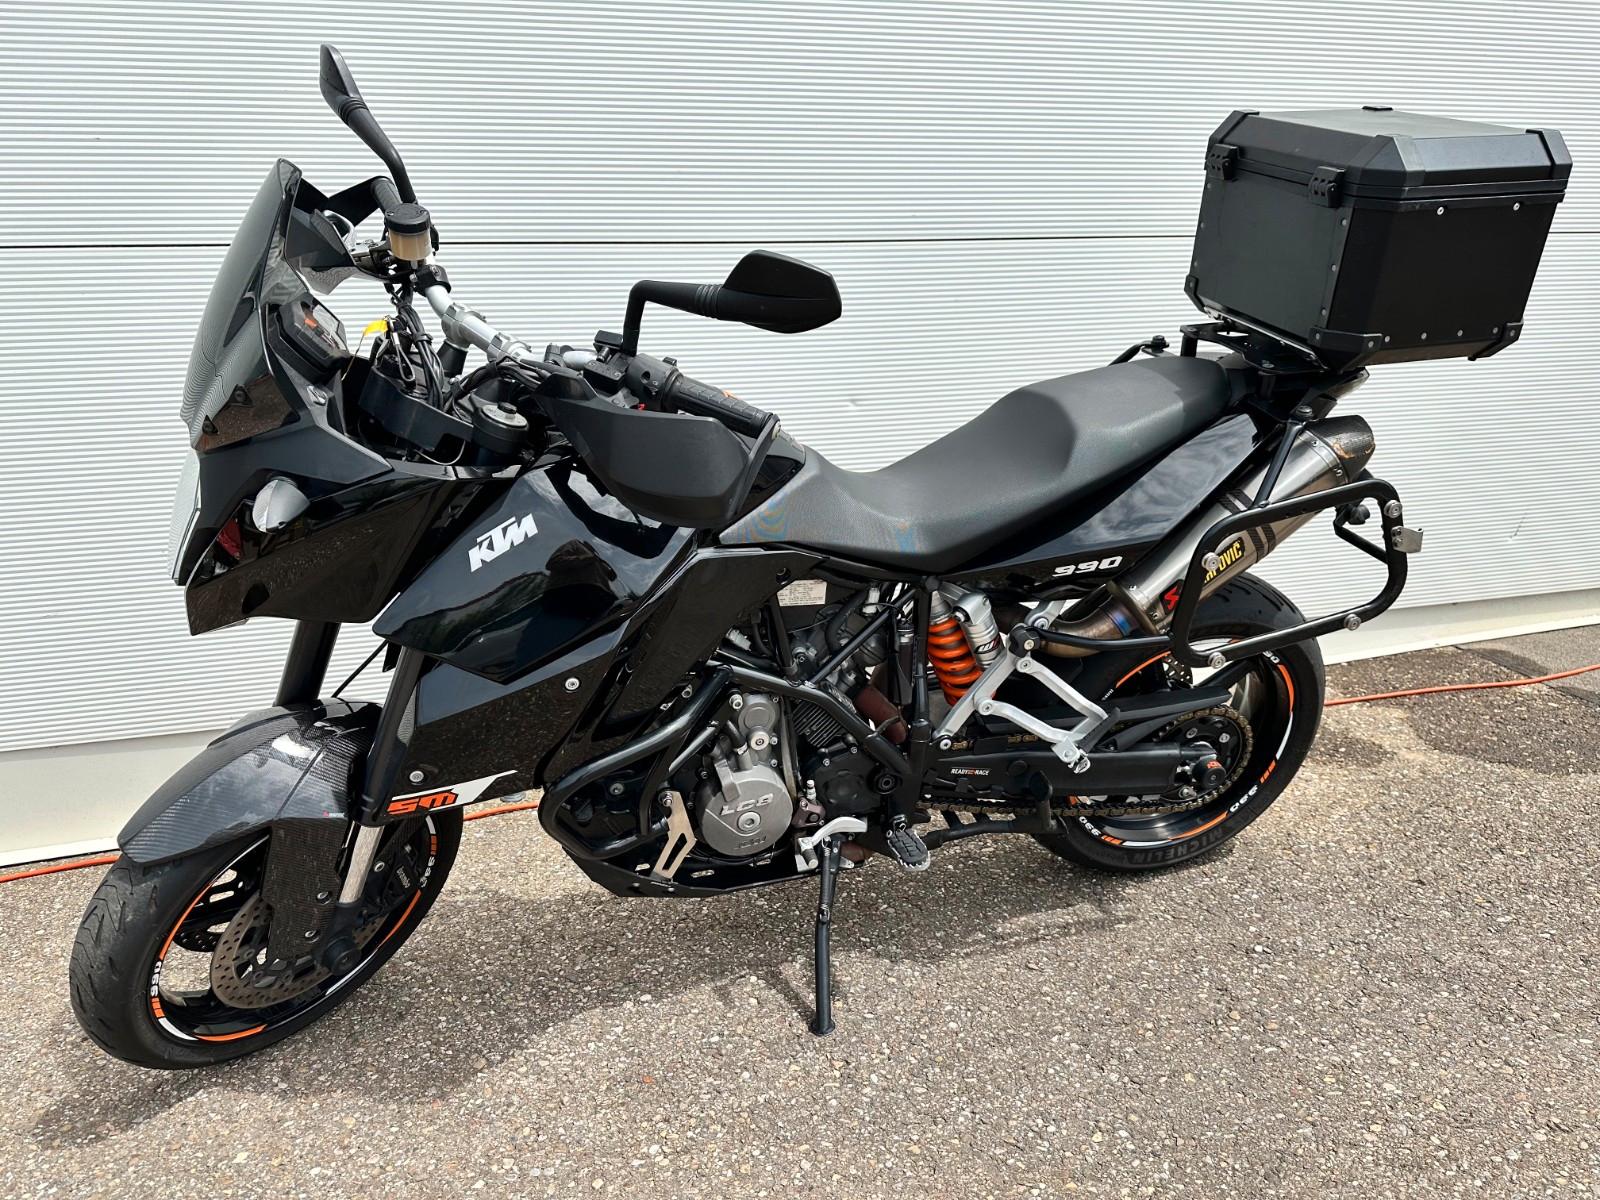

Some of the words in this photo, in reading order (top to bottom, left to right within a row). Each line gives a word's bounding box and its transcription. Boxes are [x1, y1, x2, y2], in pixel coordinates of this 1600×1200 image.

[468, 513, 538, 572] KTM
[1052, 556, 1123, 577] 990
[720, 793, 774, 816] LC8
[1132, 828, 1224, 864] MICHELIN
[150, 961, 162, 997] 990
